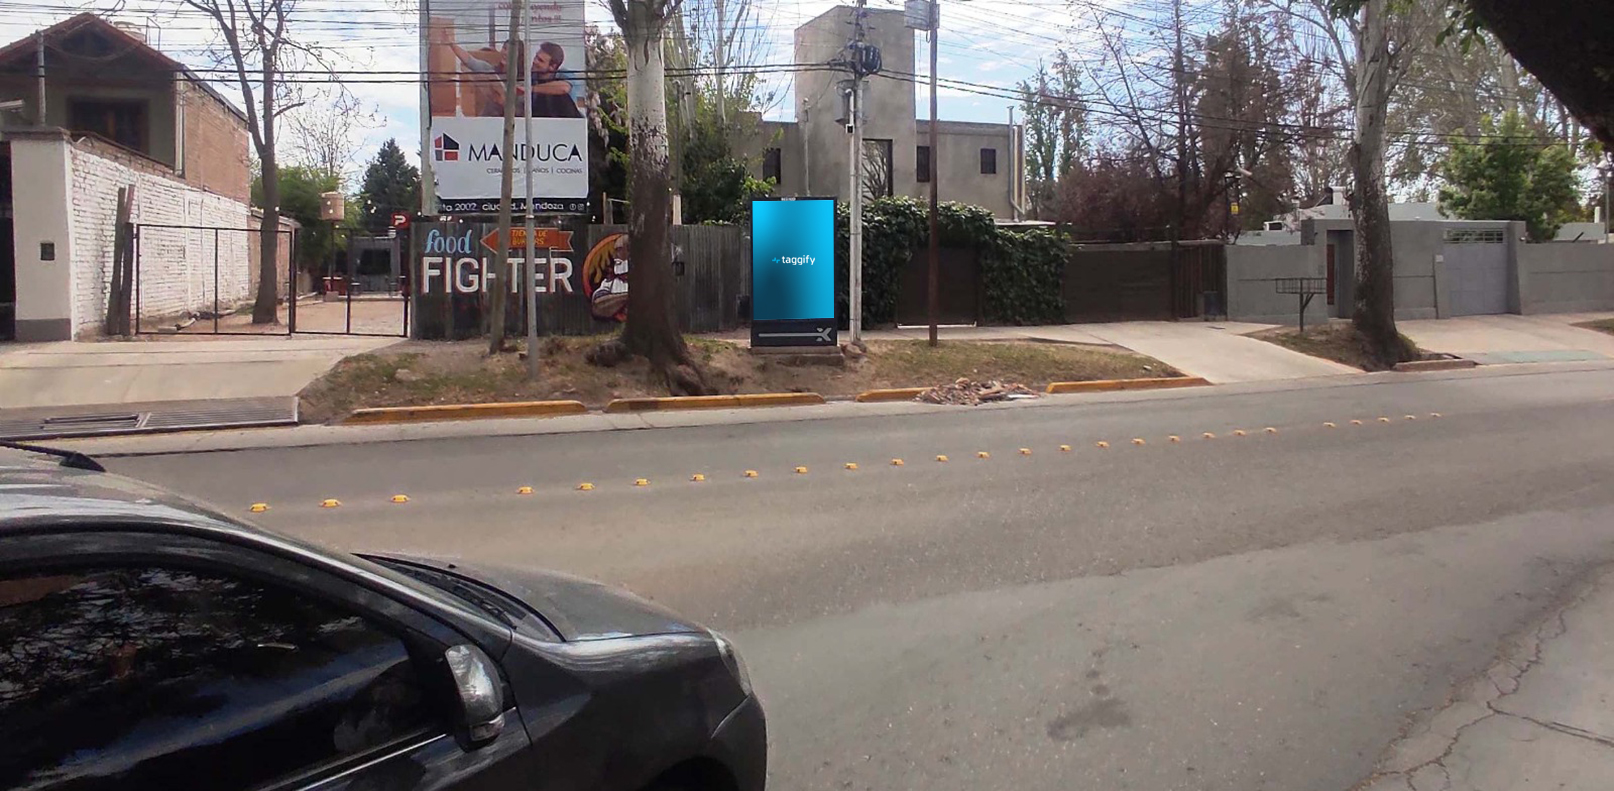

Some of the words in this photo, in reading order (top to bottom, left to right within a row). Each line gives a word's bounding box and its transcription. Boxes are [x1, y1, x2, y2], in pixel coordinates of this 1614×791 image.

[520, 201, 564, 211] Mndoza
[425, 228, 473, 255] food
[781, 254, 816, 266] taggify
[422, 256, 574, 294] FIGHTER
